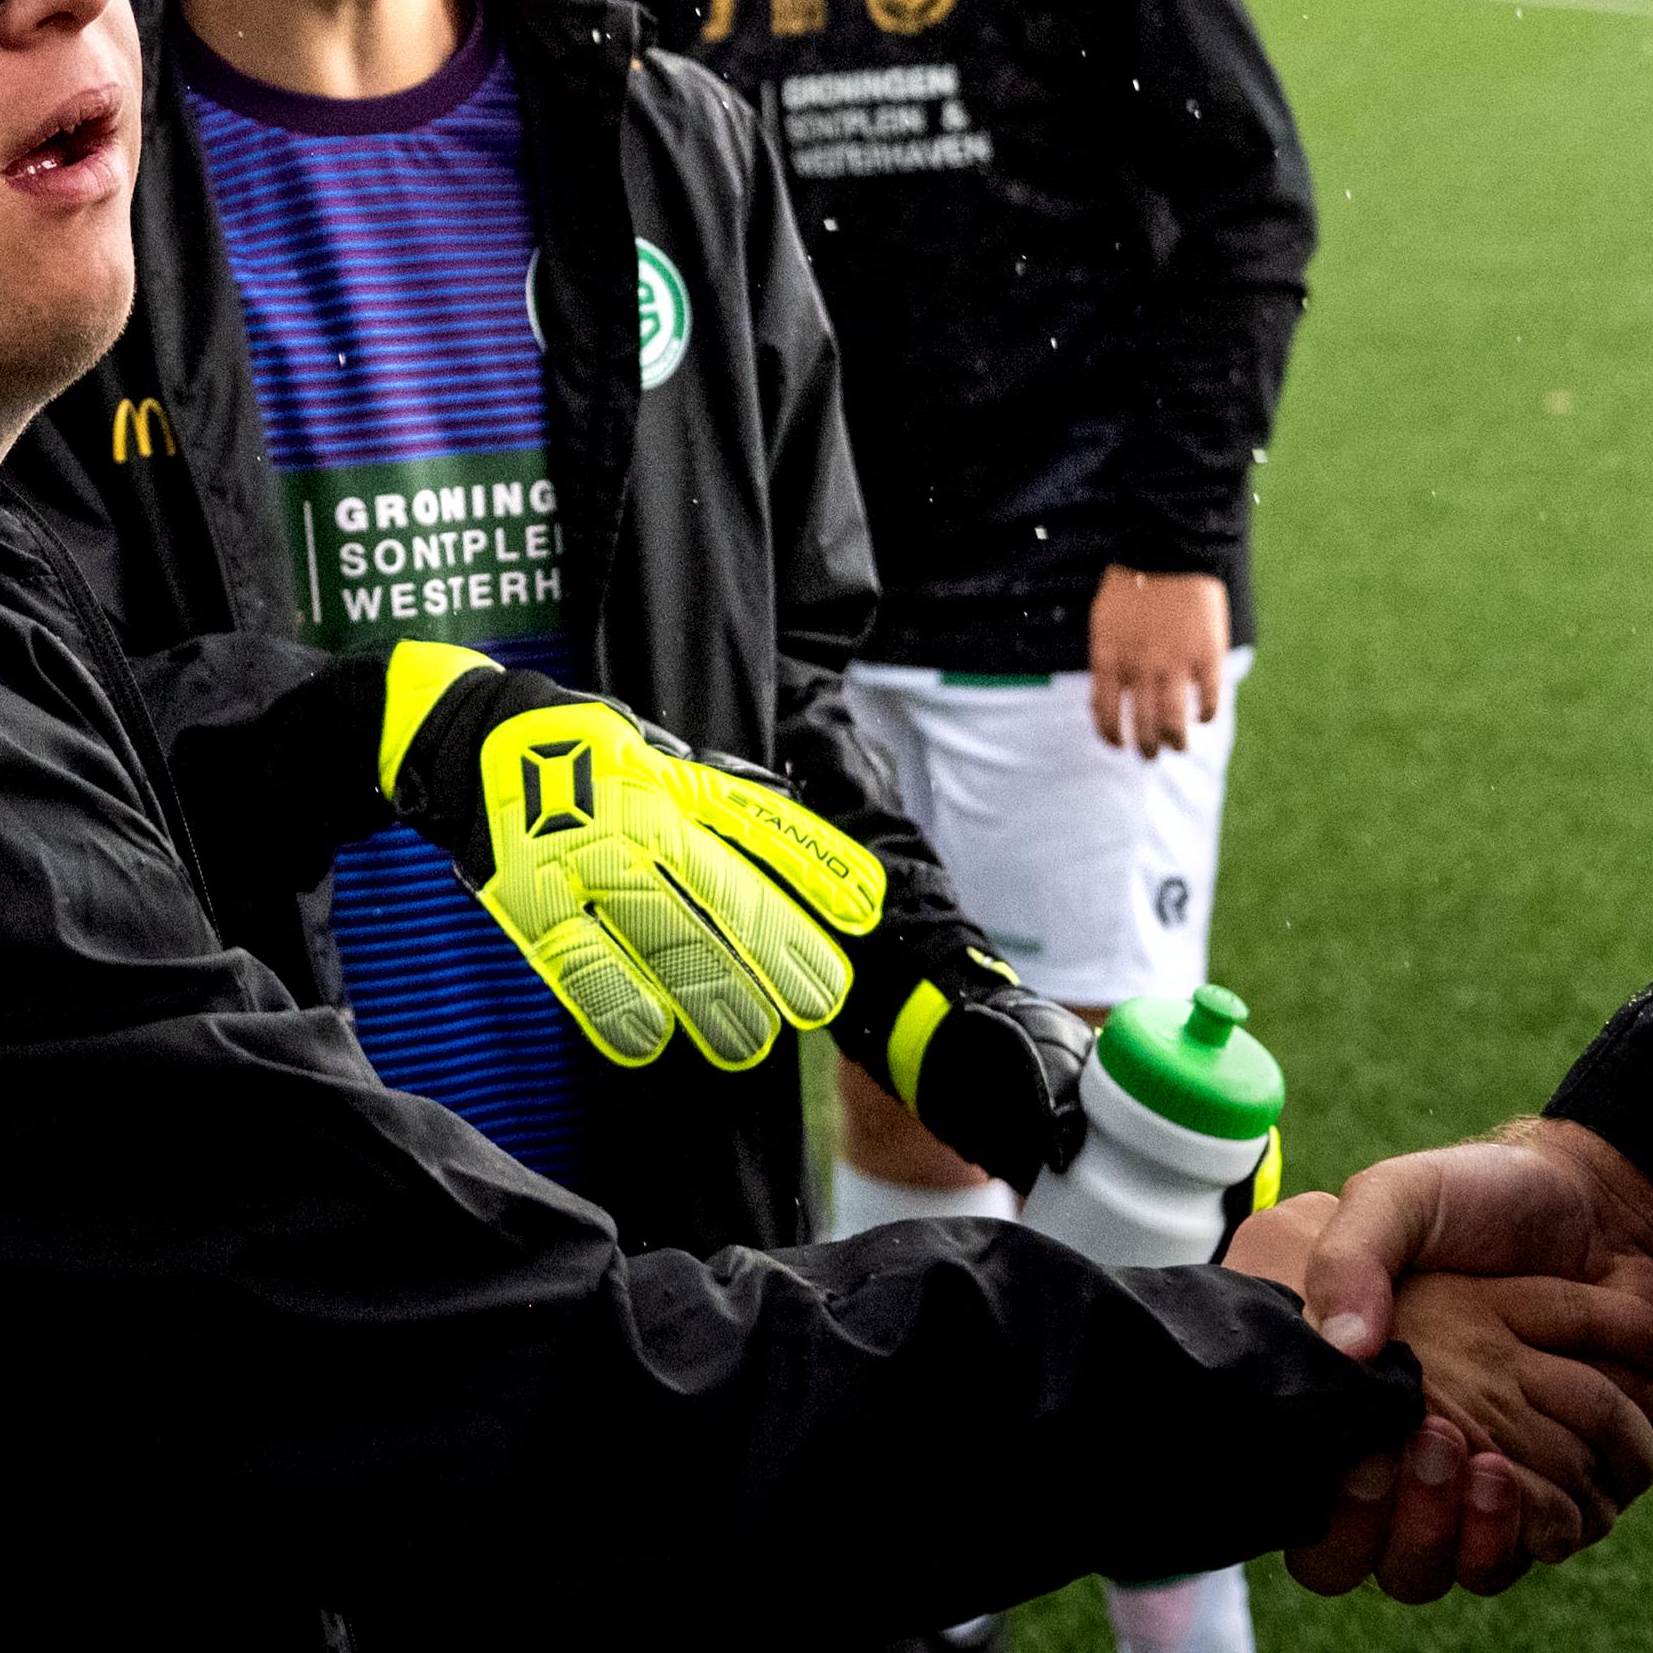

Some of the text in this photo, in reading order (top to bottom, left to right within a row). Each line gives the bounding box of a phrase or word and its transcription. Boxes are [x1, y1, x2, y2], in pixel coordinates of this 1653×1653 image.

[335, 479, 557, 532] GRONING
[342, 567, 561, 622] WESTERH
[727, 790, 850, 880] STANNO
